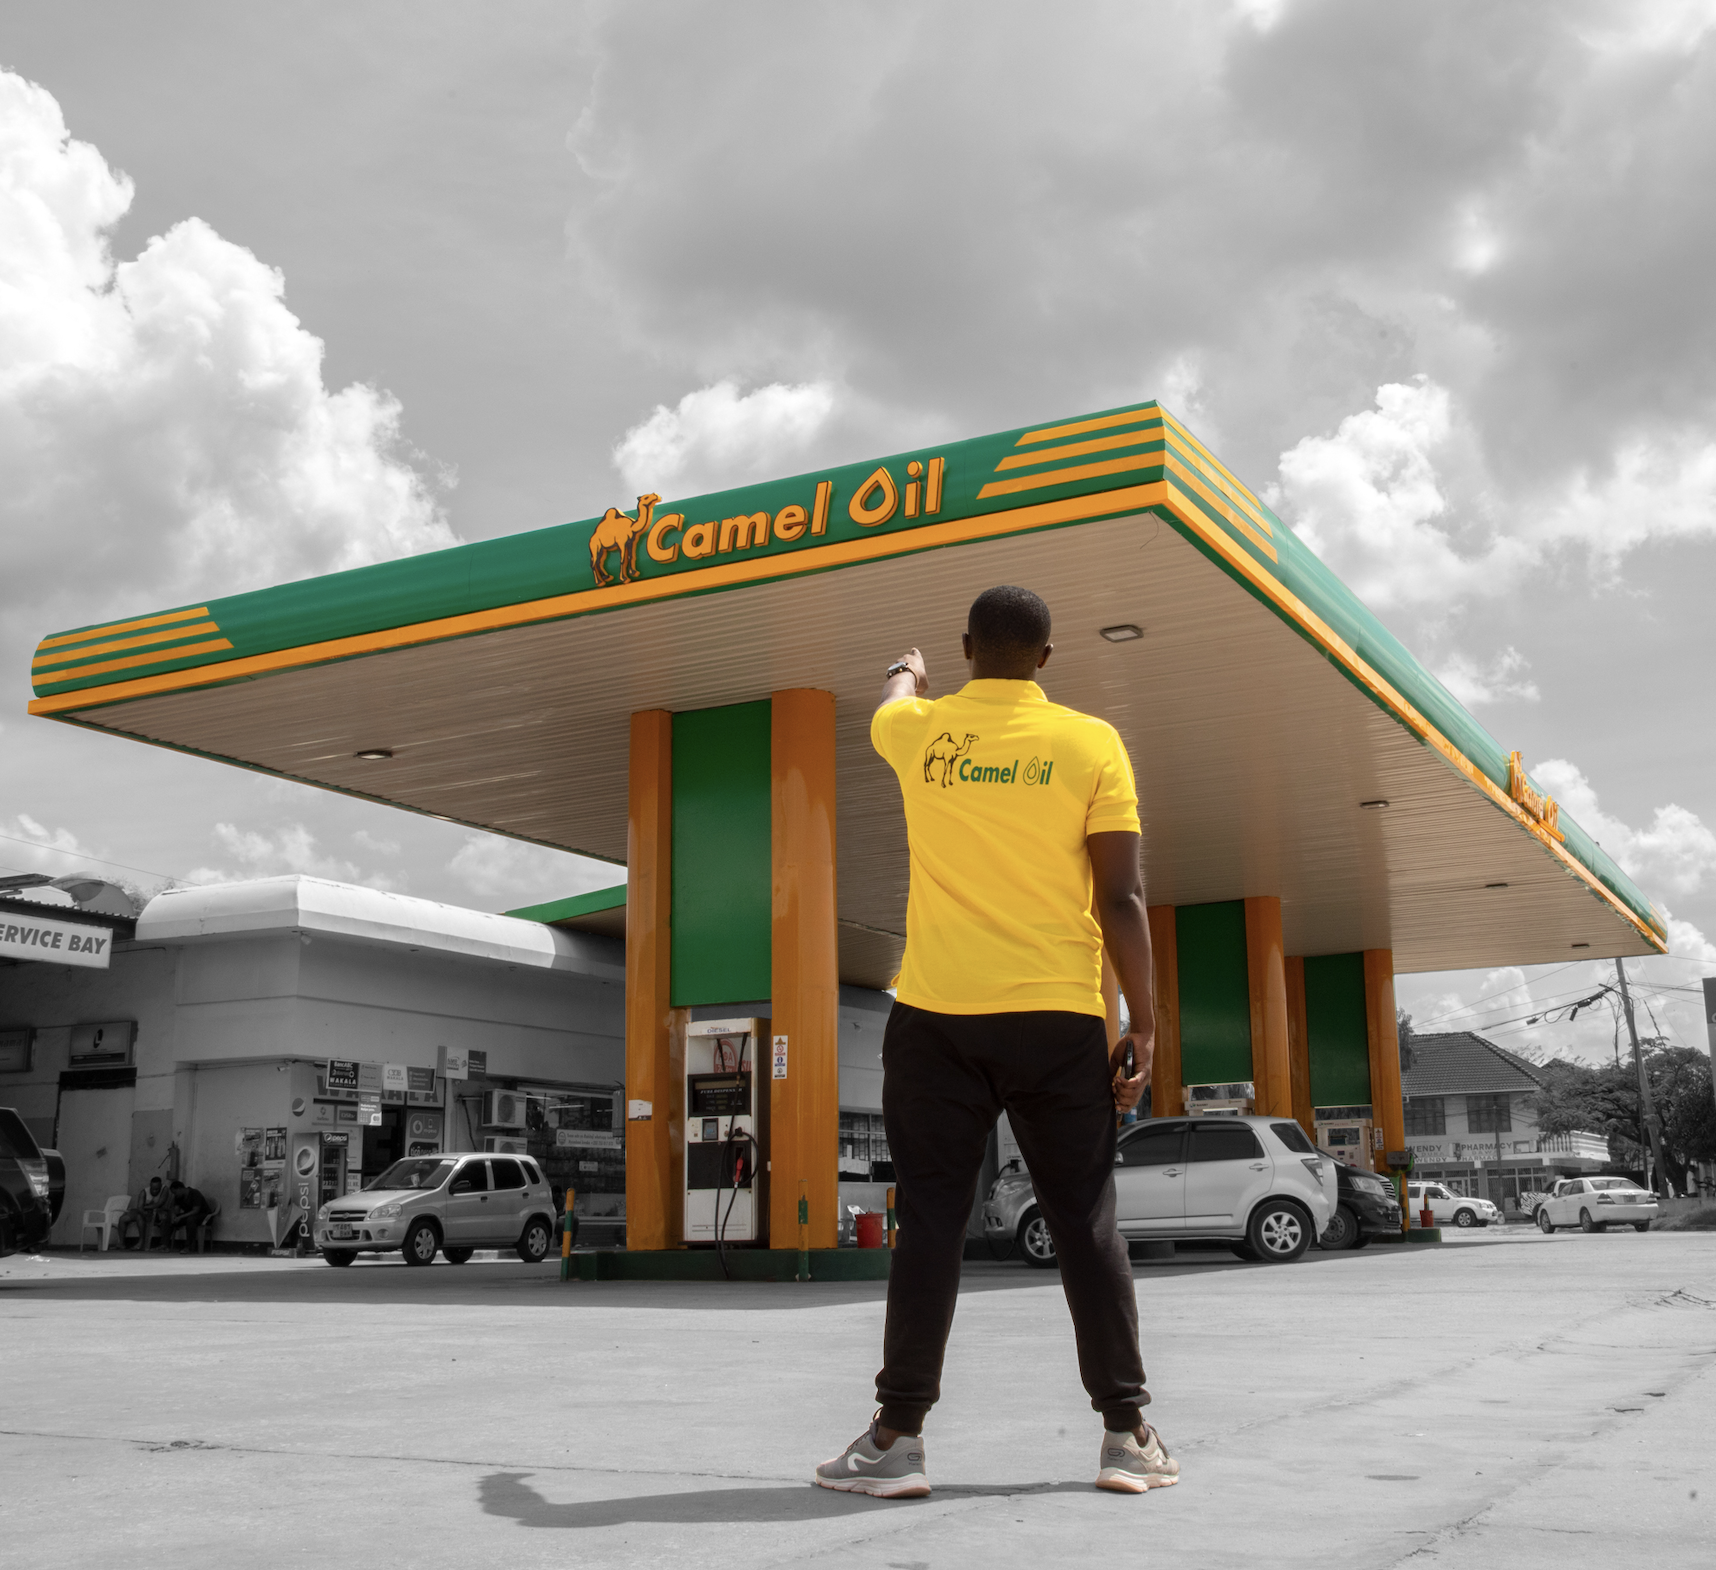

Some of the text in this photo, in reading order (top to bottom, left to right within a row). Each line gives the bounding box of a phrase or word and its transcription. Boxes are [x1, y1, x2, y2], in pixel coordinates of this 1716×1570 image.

[647, 456, 945, 564] Camel Oil
[958, 756, 1054, 786] Camel Oil
[68, 934, 108, 955] BAY
[329, 1077, 356, 1085] WAKALA
[1406, 1142, 1513, 1153] WENDY PHARMACY
[298, 1182, 311, 1238] pepsi
